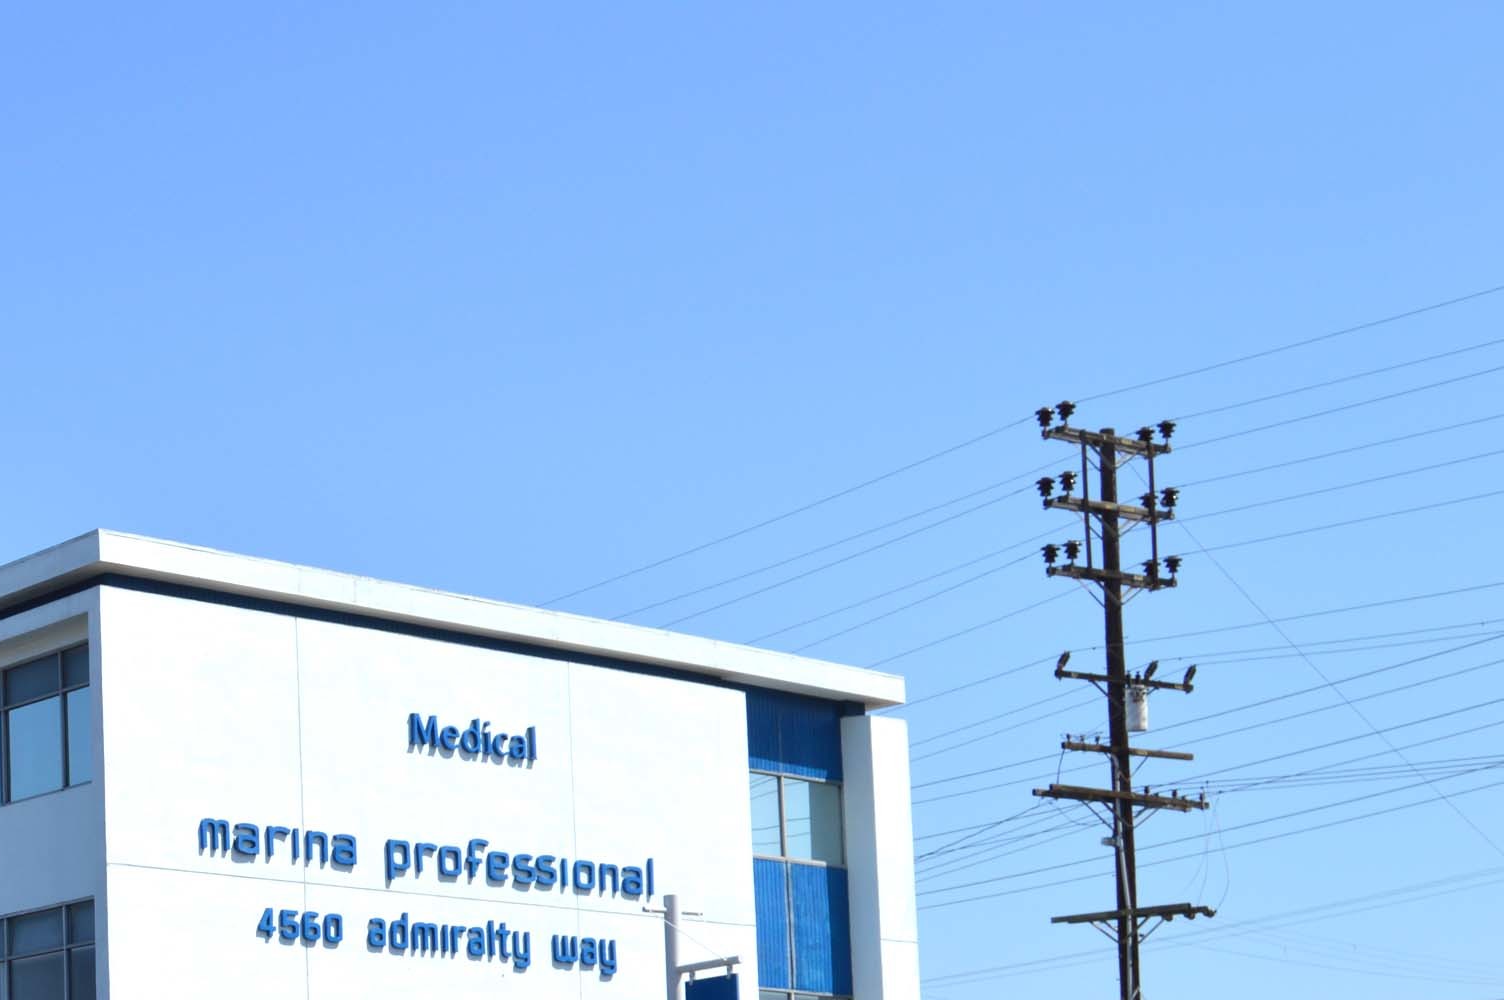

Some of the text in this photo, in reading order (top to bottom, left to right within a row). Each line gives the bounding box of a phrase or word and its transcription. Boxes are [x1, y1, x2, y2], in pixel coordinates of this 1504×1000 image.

[407, 713, 537, 762] Medical
[198, 818, 654, 897] marina professional
[257, 908, 618, 976] 4560 admiralty way
